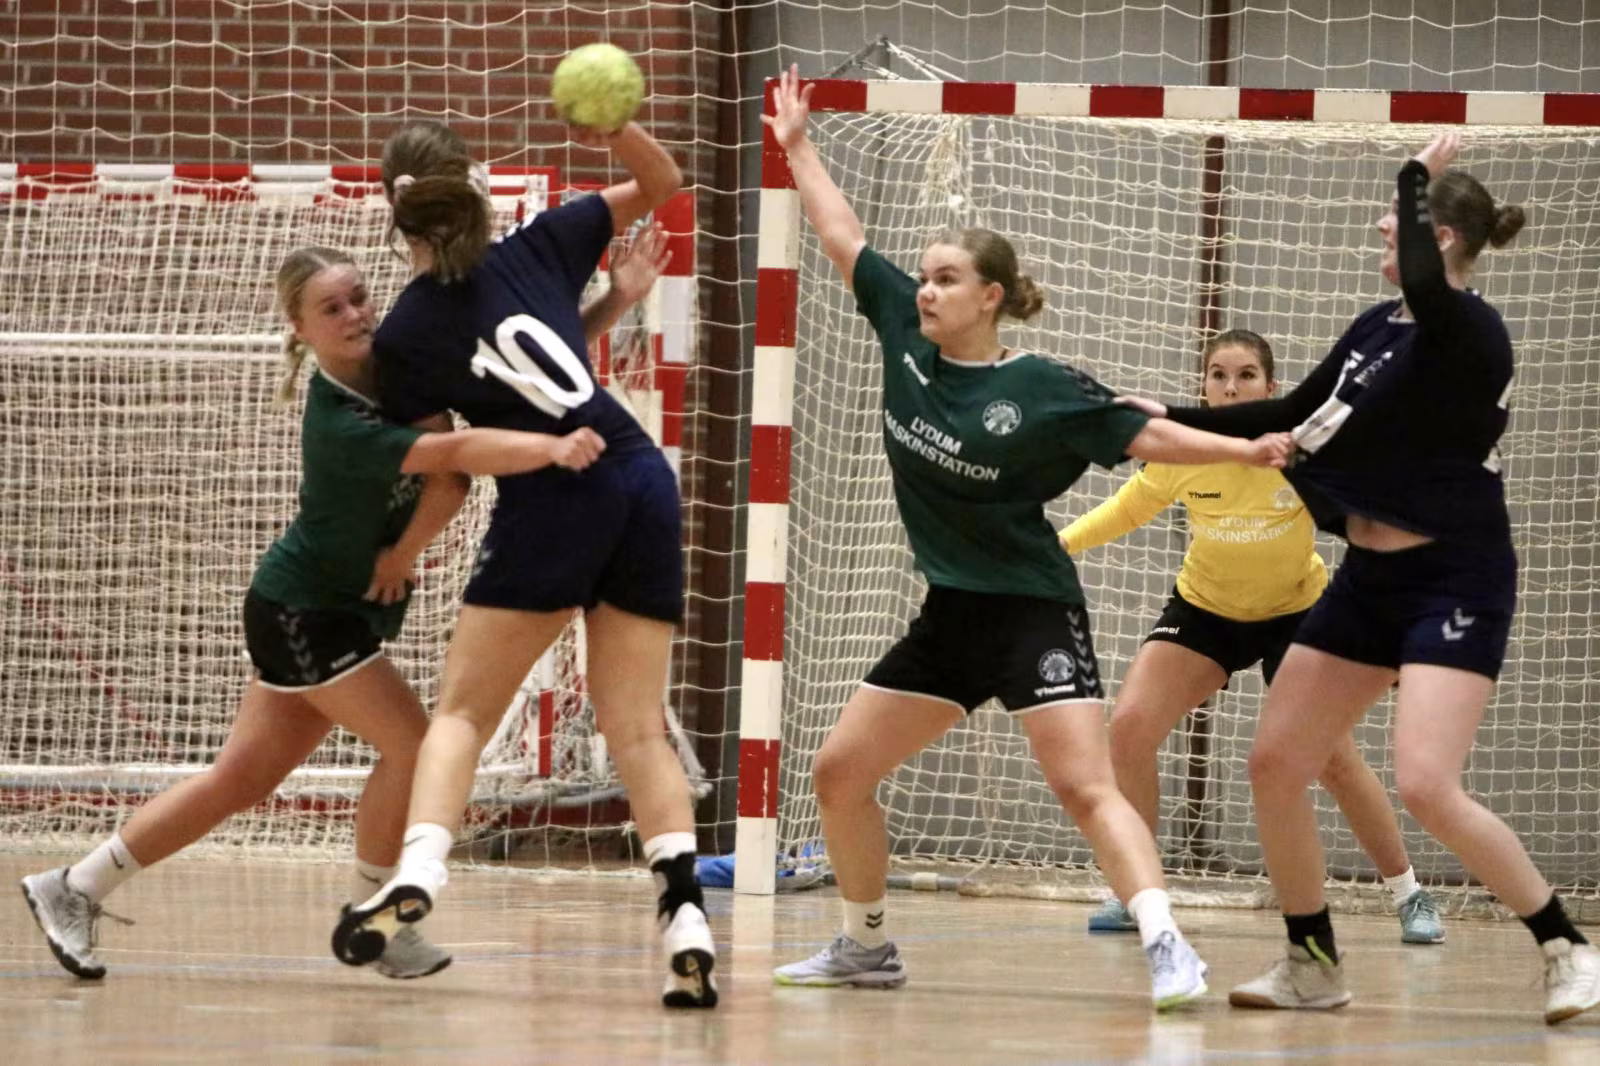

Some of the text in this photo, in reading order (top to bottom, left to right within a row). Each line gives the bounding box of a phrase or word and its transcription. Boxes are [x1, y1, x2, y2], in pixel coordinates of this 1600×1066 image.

[470, 314, 595, 420] 10
[910, 416, 962, 456] LYDUM
[1194, 491, 1222, 499] hummel
[1203, 520, 1295, 544] SKINSTATION
